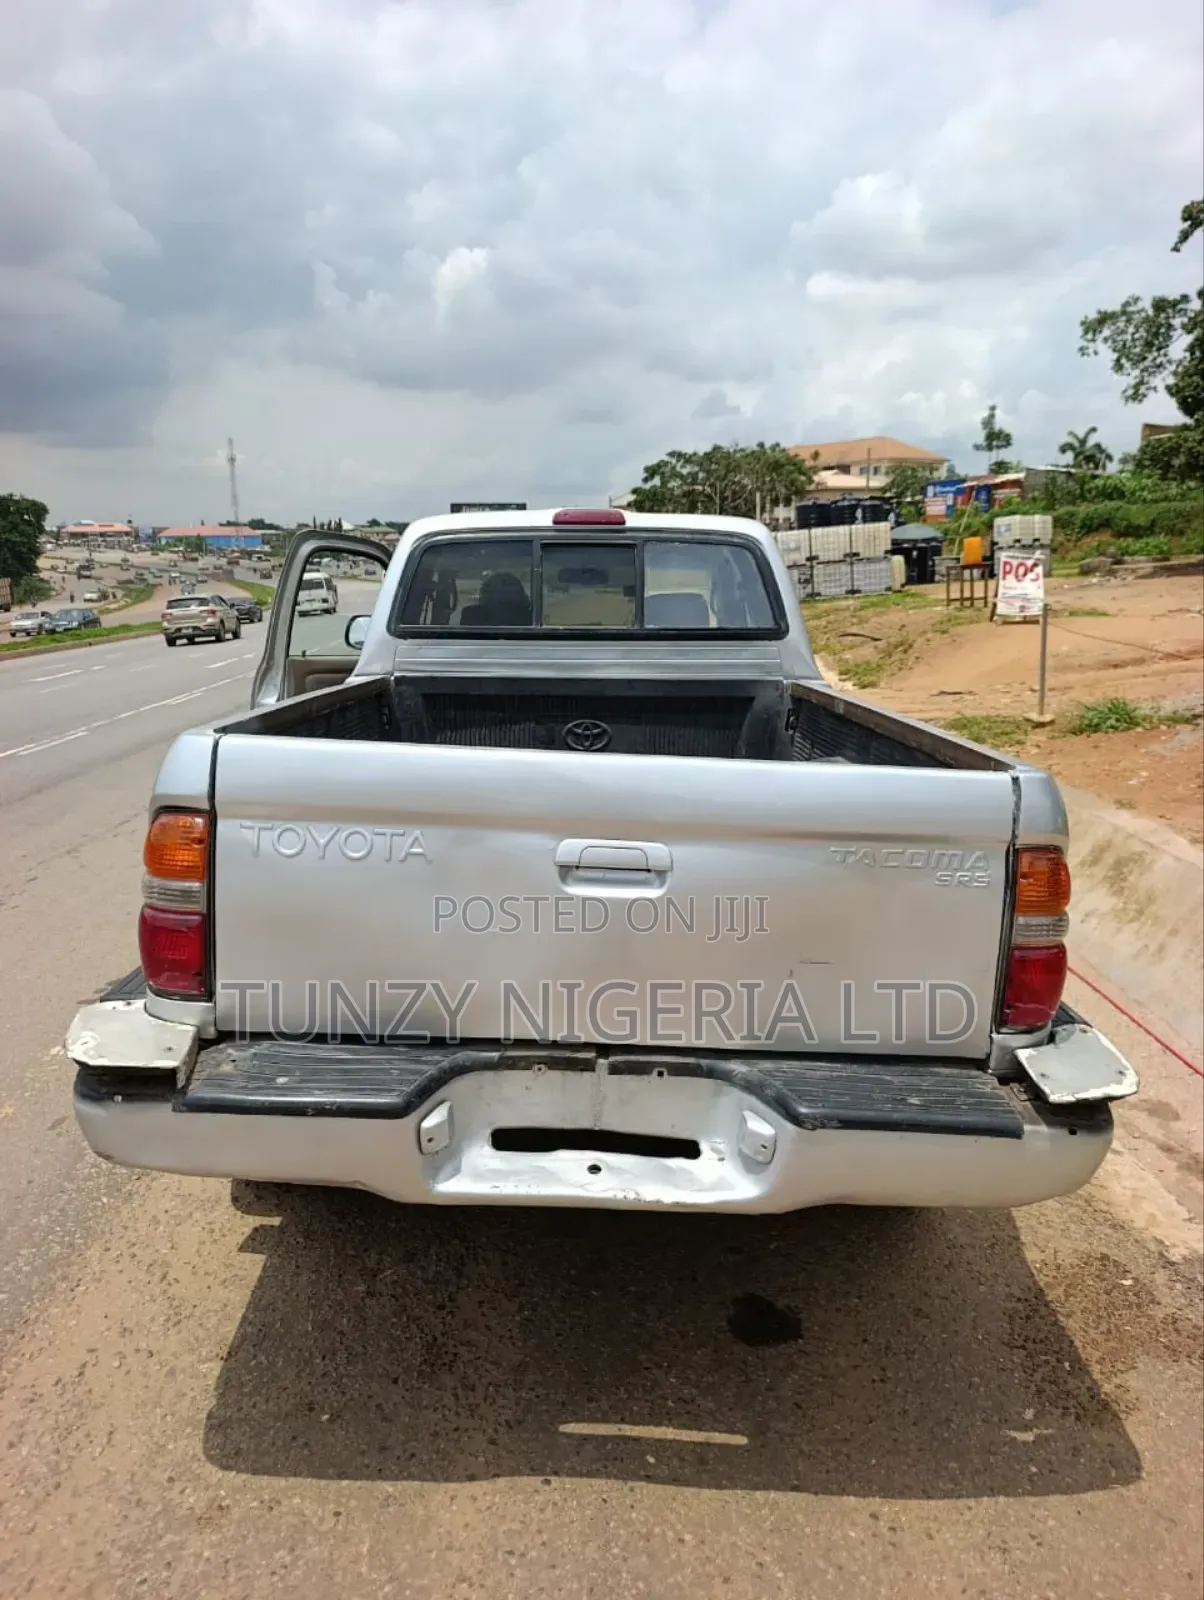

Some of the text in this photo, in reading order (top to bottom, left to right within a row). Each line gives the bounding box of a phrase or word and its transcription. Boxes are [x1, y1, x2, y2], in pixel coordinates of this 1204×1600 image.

[1002, 561, 1040, 582] POS
[239, 822, 433, 864] TOYOTA
[829, 846, 988, 870] TACOMA
